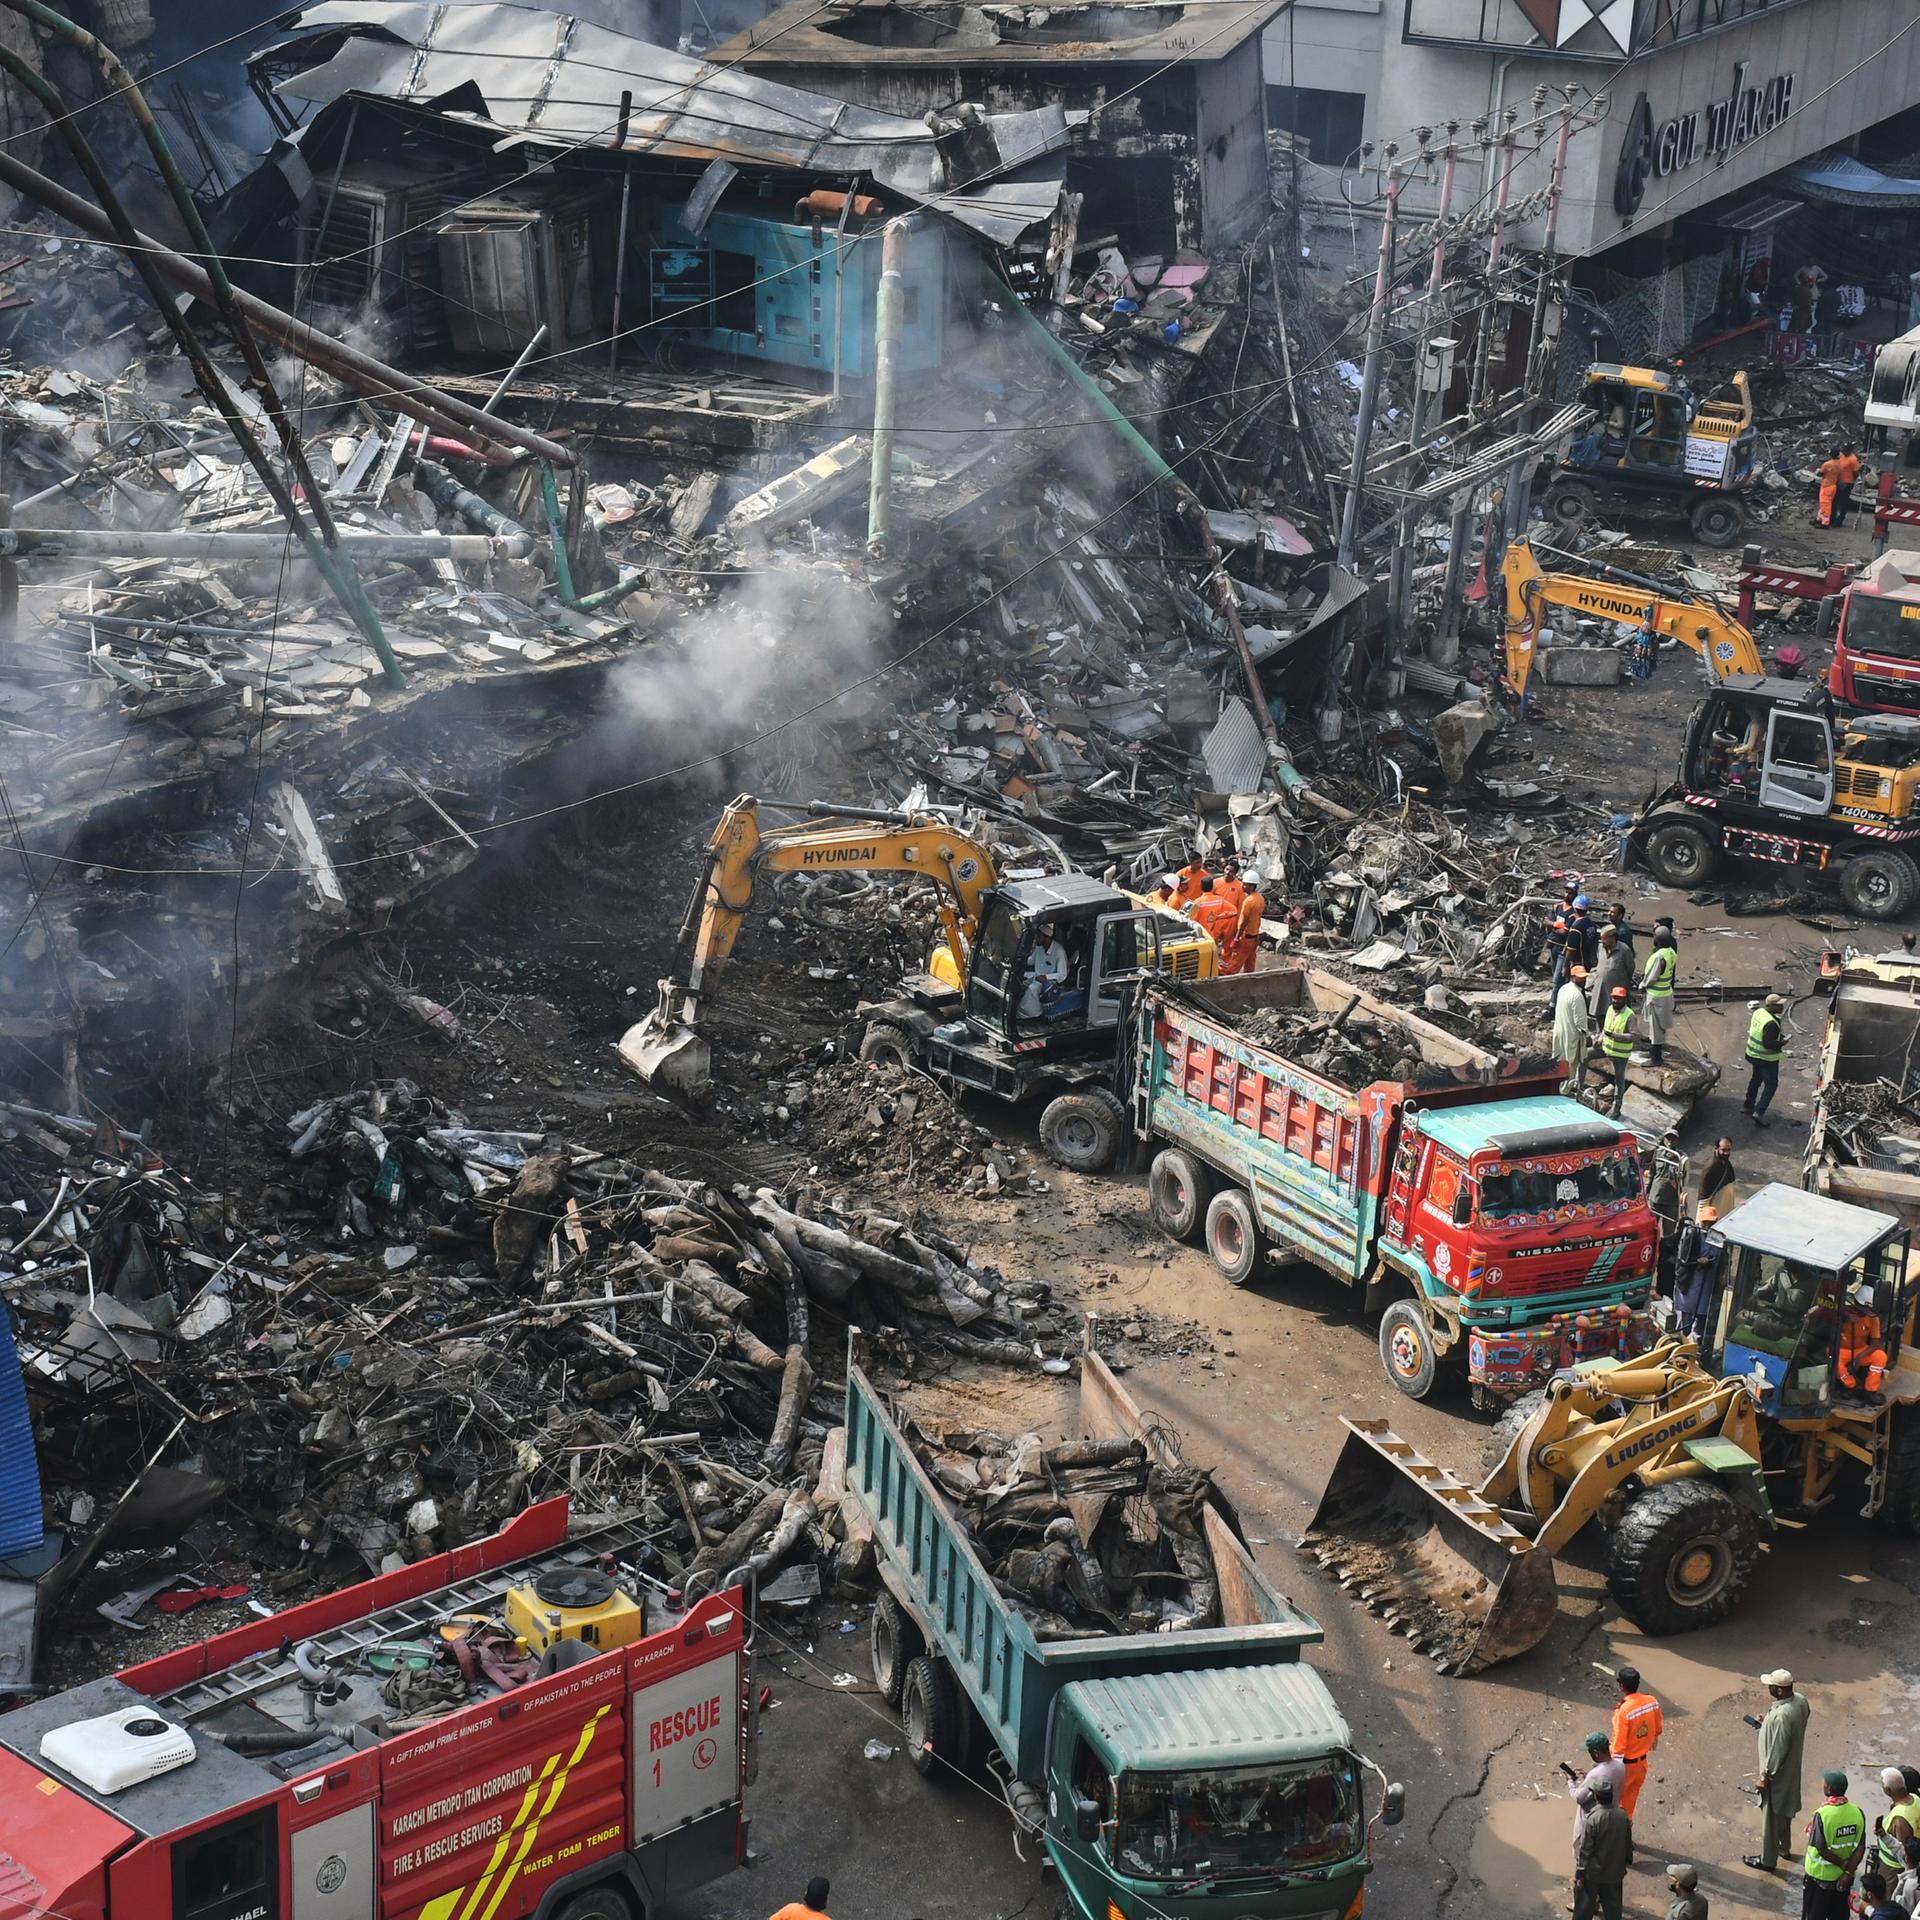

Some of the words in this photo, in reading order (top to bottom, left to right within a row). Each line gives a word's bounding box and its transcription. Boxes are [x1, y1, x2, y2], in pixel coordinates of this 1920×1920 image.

[1655, 112, 1702, 176] GUL
[1705, 61, 1796, 166] TIJARAH
[1578, 592, 1644, 618] HYUNDA
[803, 847, 876, 864] HYUNDAI
[1515, 1244, 1573, 1257] NISSAN
[1579, 1235, 1632, 1249] DIESEL
[1606, 1414, 1697, 1469] LIUGONG
[389, 1756, 395, 1767] A
[396, 1748, 414, 1763] GIFT
[414, 1739, 436, 1756] FROM
[436, 1730, 458, 1748] PRIME
[459, 1717, 493, 1737] MINISTER
[523, 1701, 533, 1712] OF
[534, 1685, 569, 1707] PAKISTAN
[570, 1682, 580, 1694] TO
[581, 1674, 594, 1689] THE
[595, 1665, 622, 1683] PEOPLE
[633, 1656, 644, 1668] OF
[644, 1644, 675, 1663] KARACHI
[650, 1695, 721, 1753] RESCUE
[653, 1758, 662, 1788] 1
[393, 1809, 425, 1837] KARACHI
[426, 1785, 481, 1823] METROPOITAN
[482, 1764, 532, 1799] CORPORATION
[393, 1852, 413, 1877] FIRE
[415, 1849, 422, 1867] &
[424, 1833, 459, 1863] RESCUE
[460, 1815, 502, 1848] SERVICES
[523, 1854, 553, 1875] WATER
[558, 1842, 582, 1860] FOAM
[586, 1825, 620, 1848] TENDER
[1837, 1826, 1855, 1836] KMC
